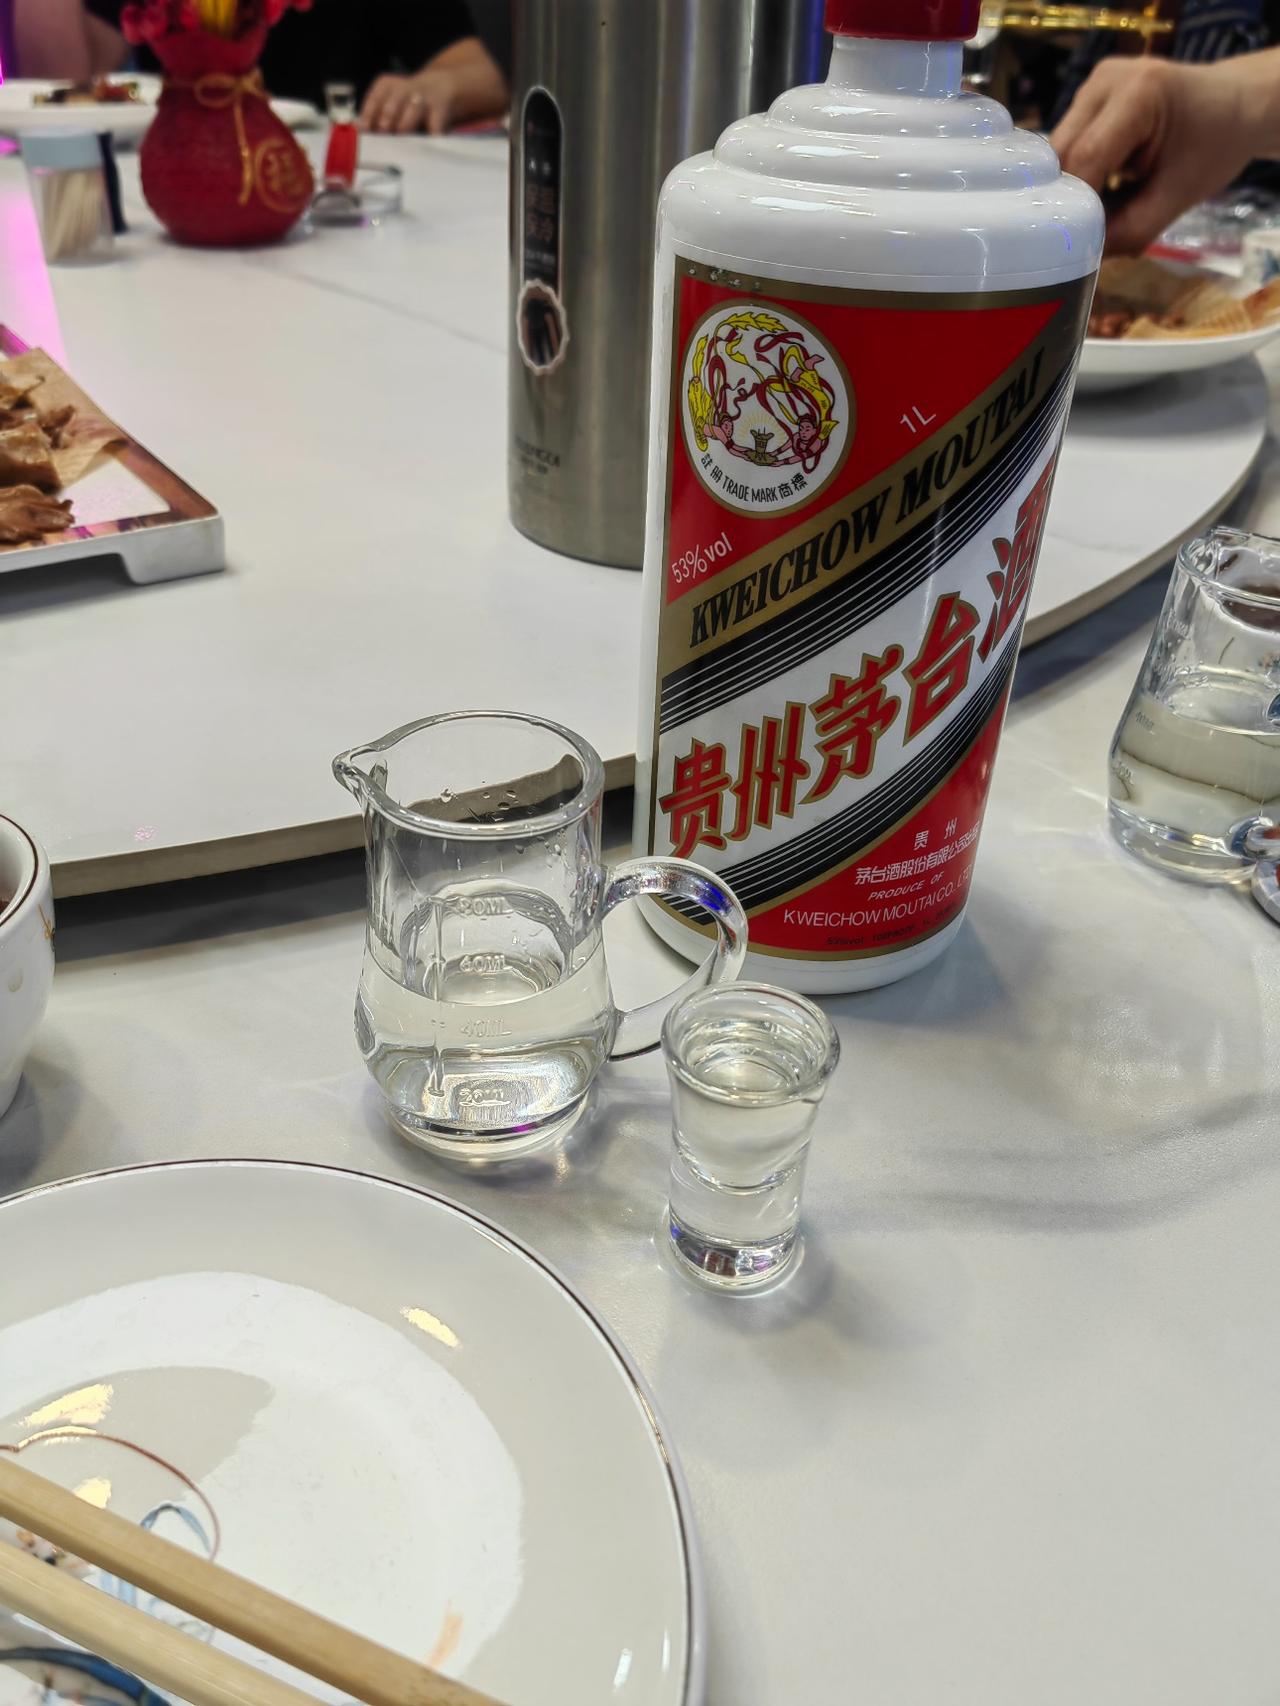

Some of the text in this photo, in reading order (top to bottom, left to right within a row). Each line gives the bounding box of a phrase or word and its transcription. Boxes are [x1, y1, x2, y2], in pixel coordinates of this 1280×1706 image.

[900, 406, 936, 433] 1L
[690, 346, 1045, 648] KWEICHOW MOUTAI
[723, 475, 750, 502] TRADE
[751, 486, 778, 502] MARK
[867, 871, 944, 901] PRODUCE OF
[783, 908, 881, 927] KWEICHOW
[882, 892, 936, 922] MOUTAI
[460, 954, 513, 972] 60ML
[460, 1017, 512, 1038] 40ML
